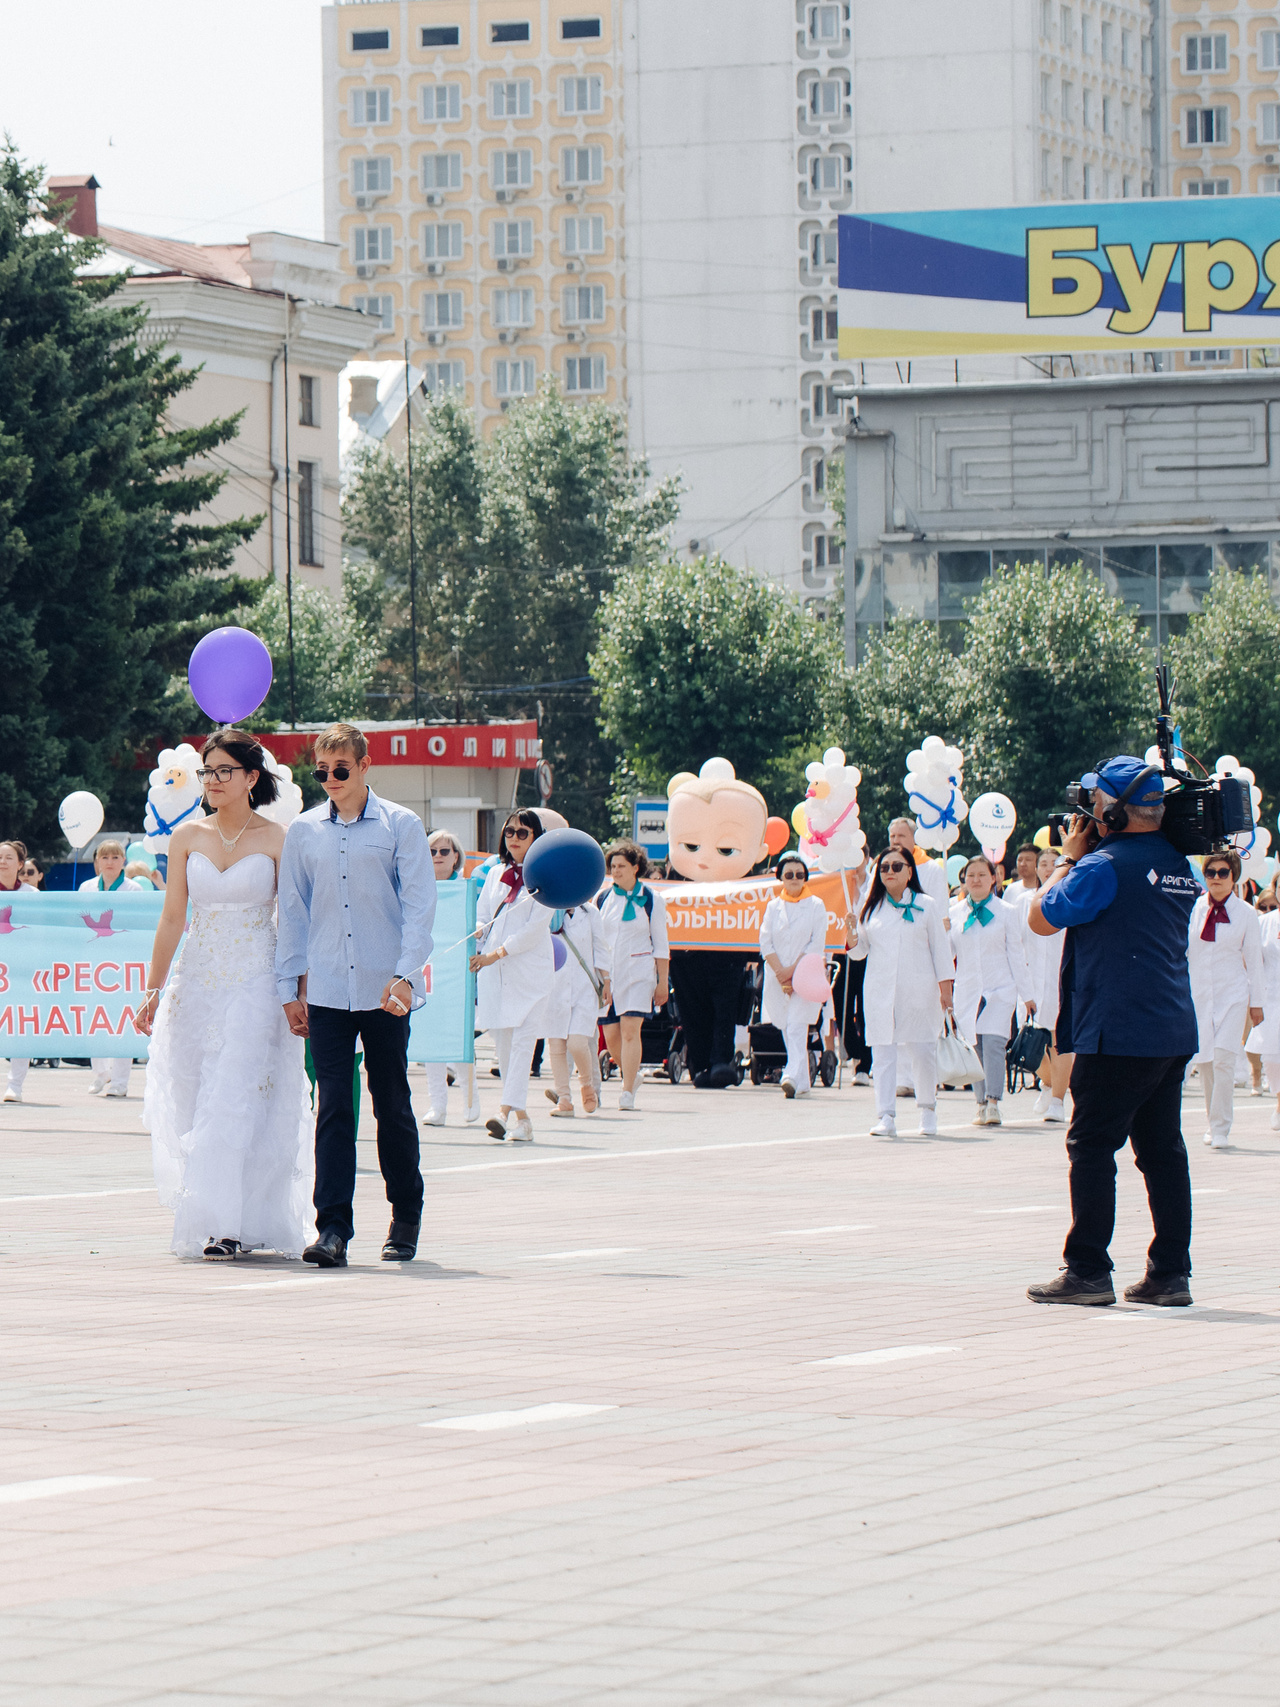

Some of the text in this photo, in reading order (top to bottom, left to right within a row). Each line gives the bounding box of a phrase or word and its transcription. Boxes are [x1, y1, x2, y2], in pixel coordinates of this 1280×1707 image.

[1026, 226, 1280, 335] Бур
[1161, 874, 1195, 888] АРИГУС
[32, 962, 168, 993] «РЕСП
